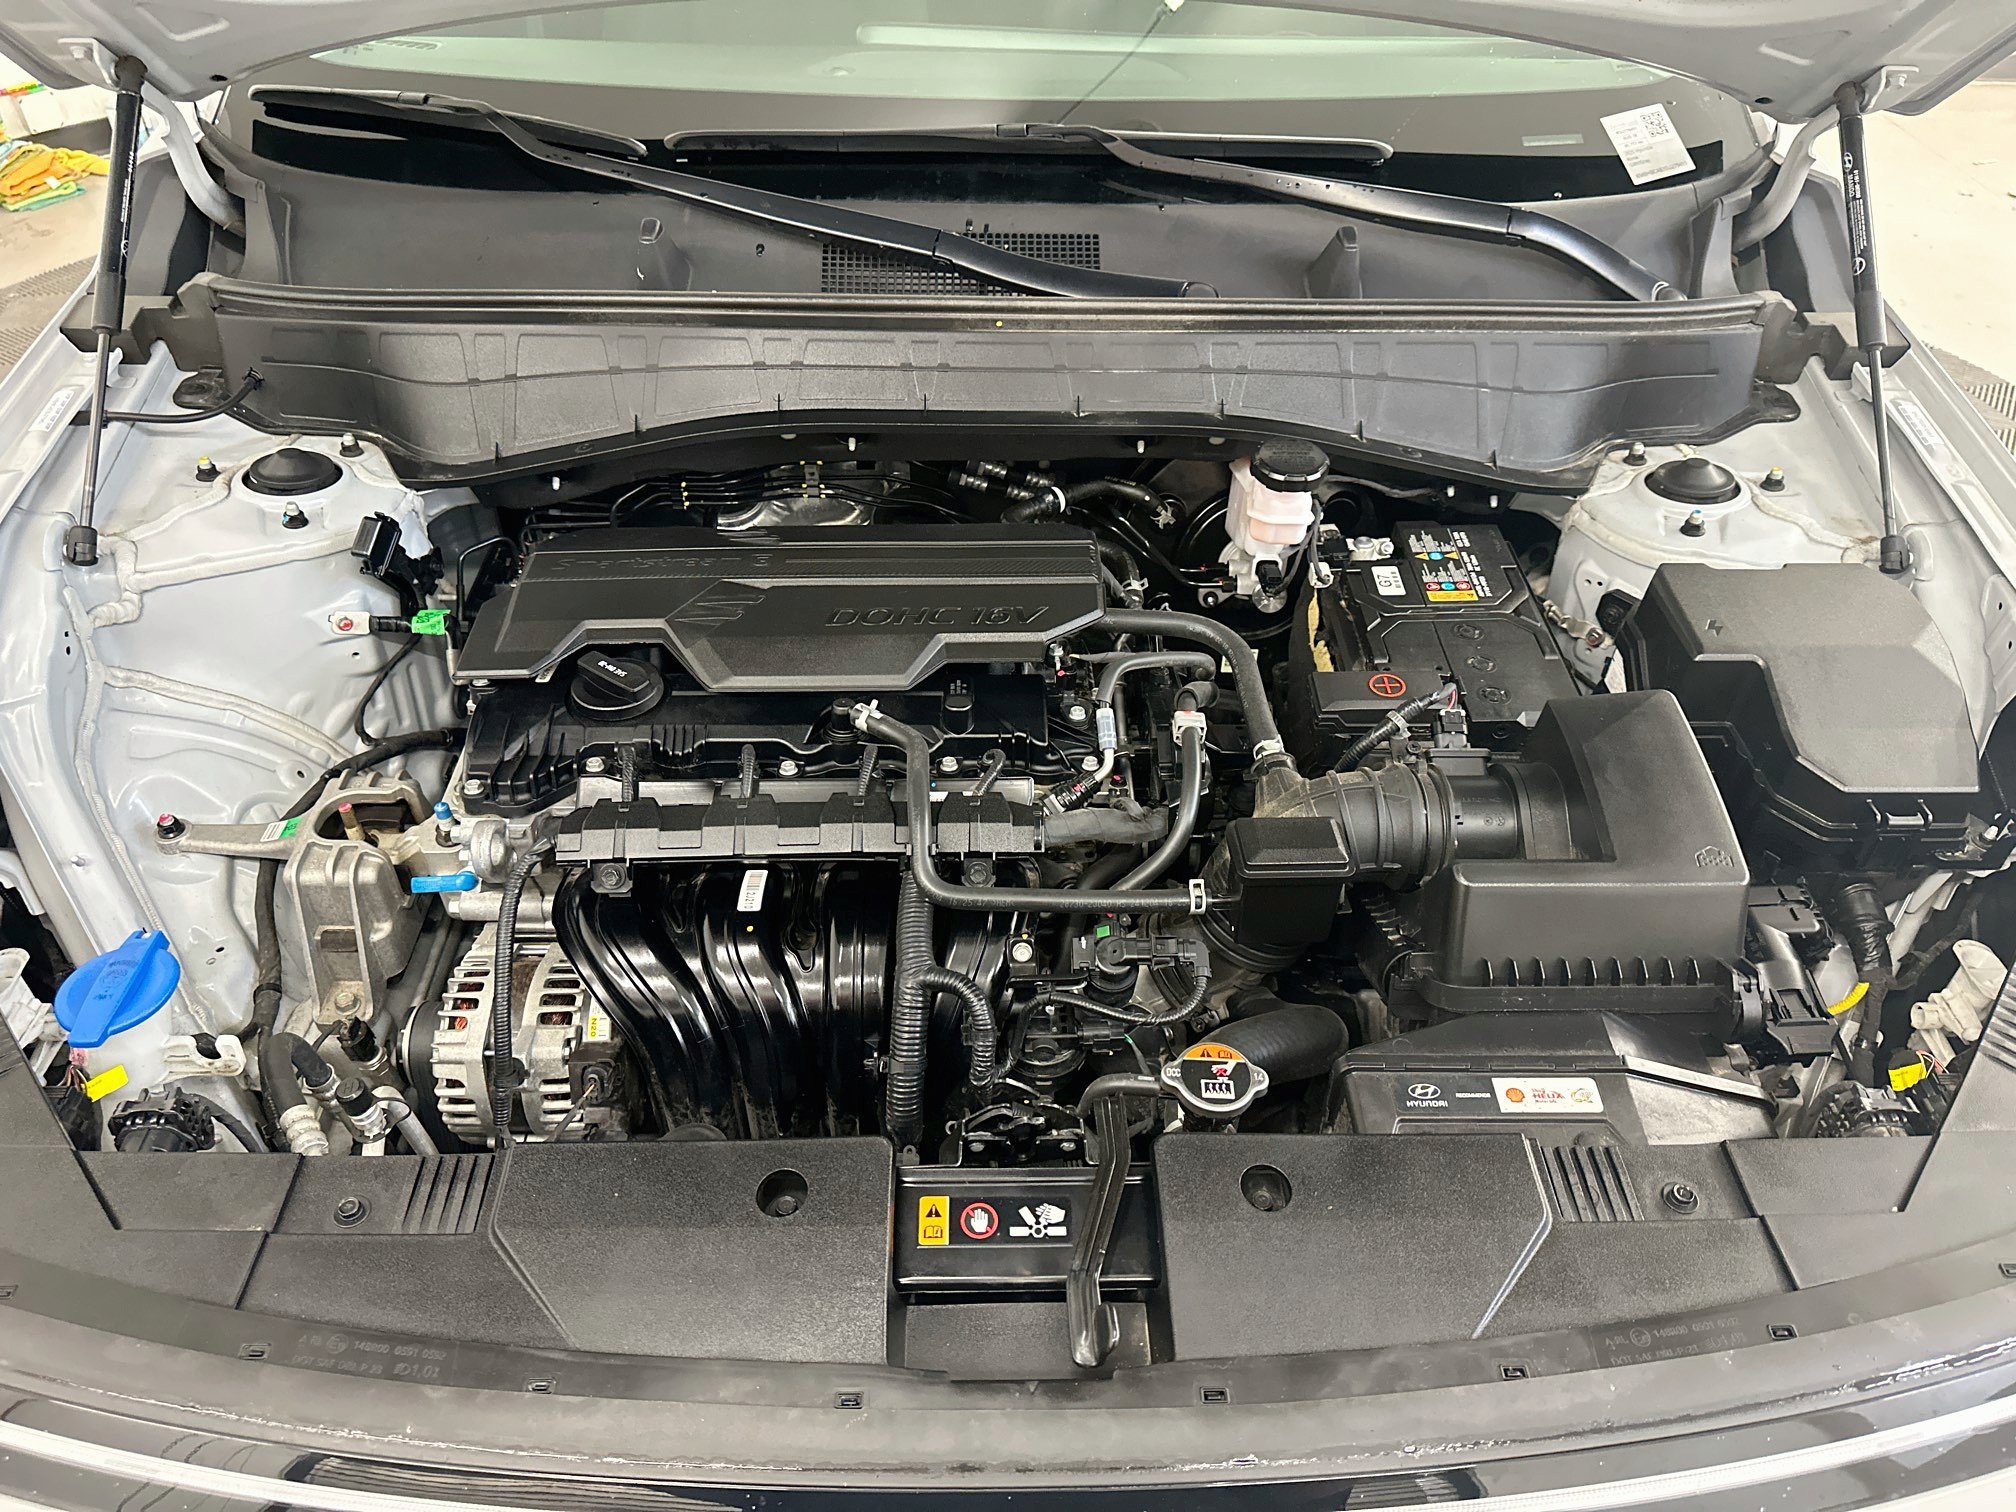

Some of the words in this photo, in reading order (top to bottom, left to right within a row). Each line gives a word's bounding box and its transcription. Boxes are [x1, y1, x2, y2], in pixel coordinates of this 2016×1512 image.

[1376, 574, 1393, 588] G7
[825, 606, 961, 627] DOHC
[970, 606, 1049, 625] 16V
[1406, 1100, 1448, 1108] HYUNDAI
